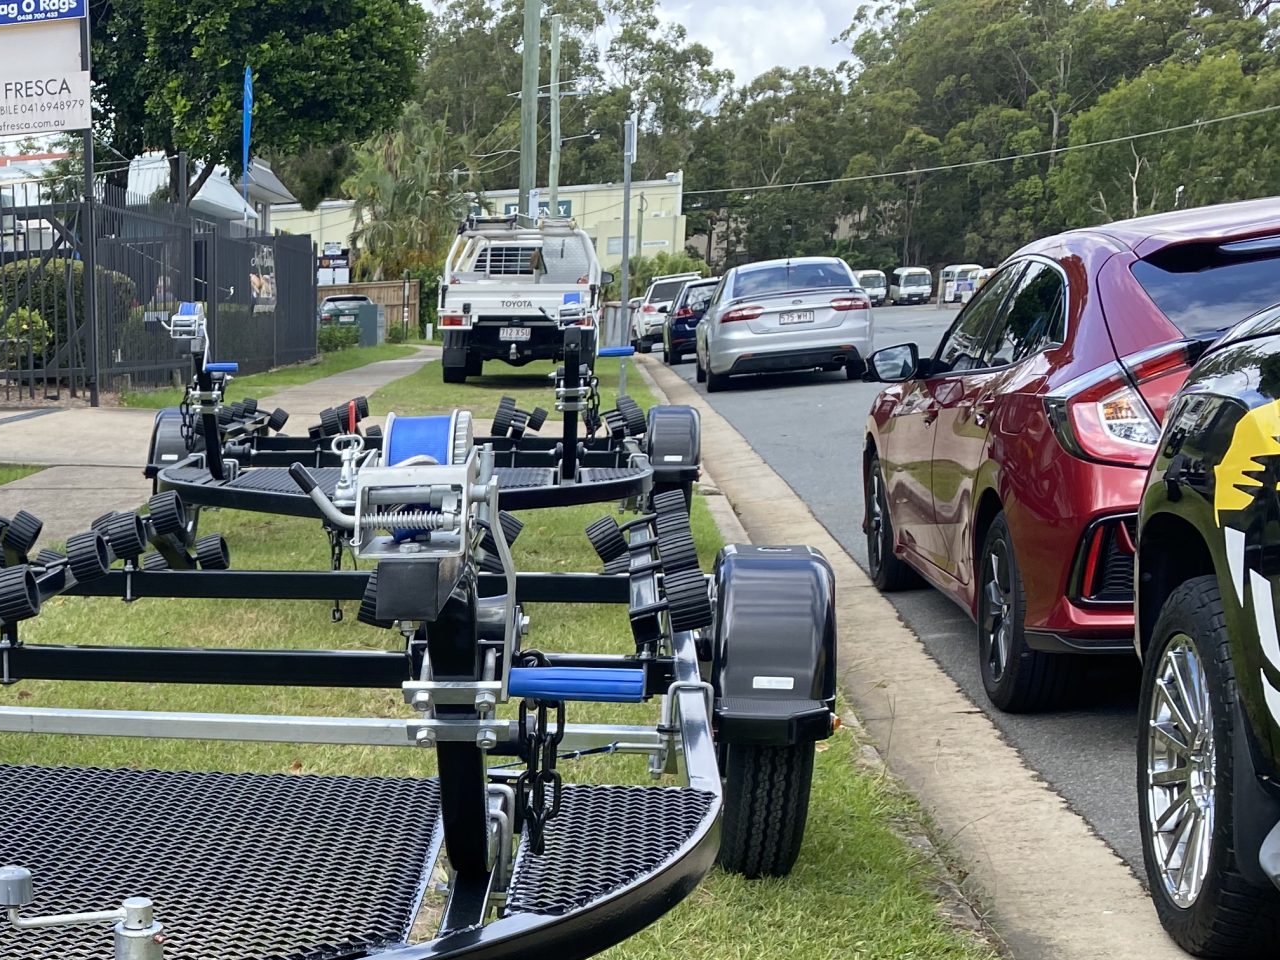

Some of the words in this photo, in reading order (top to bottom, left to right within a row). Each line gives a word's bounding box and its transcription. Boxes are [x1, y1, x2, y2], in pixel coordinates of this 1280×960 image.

[22, 0, 35, 12] O
[4, 77, 71, 100] FRESCA
[20, 99, 85, 114] 0416948979
[500, 300, 533, 308] TOYOTA
